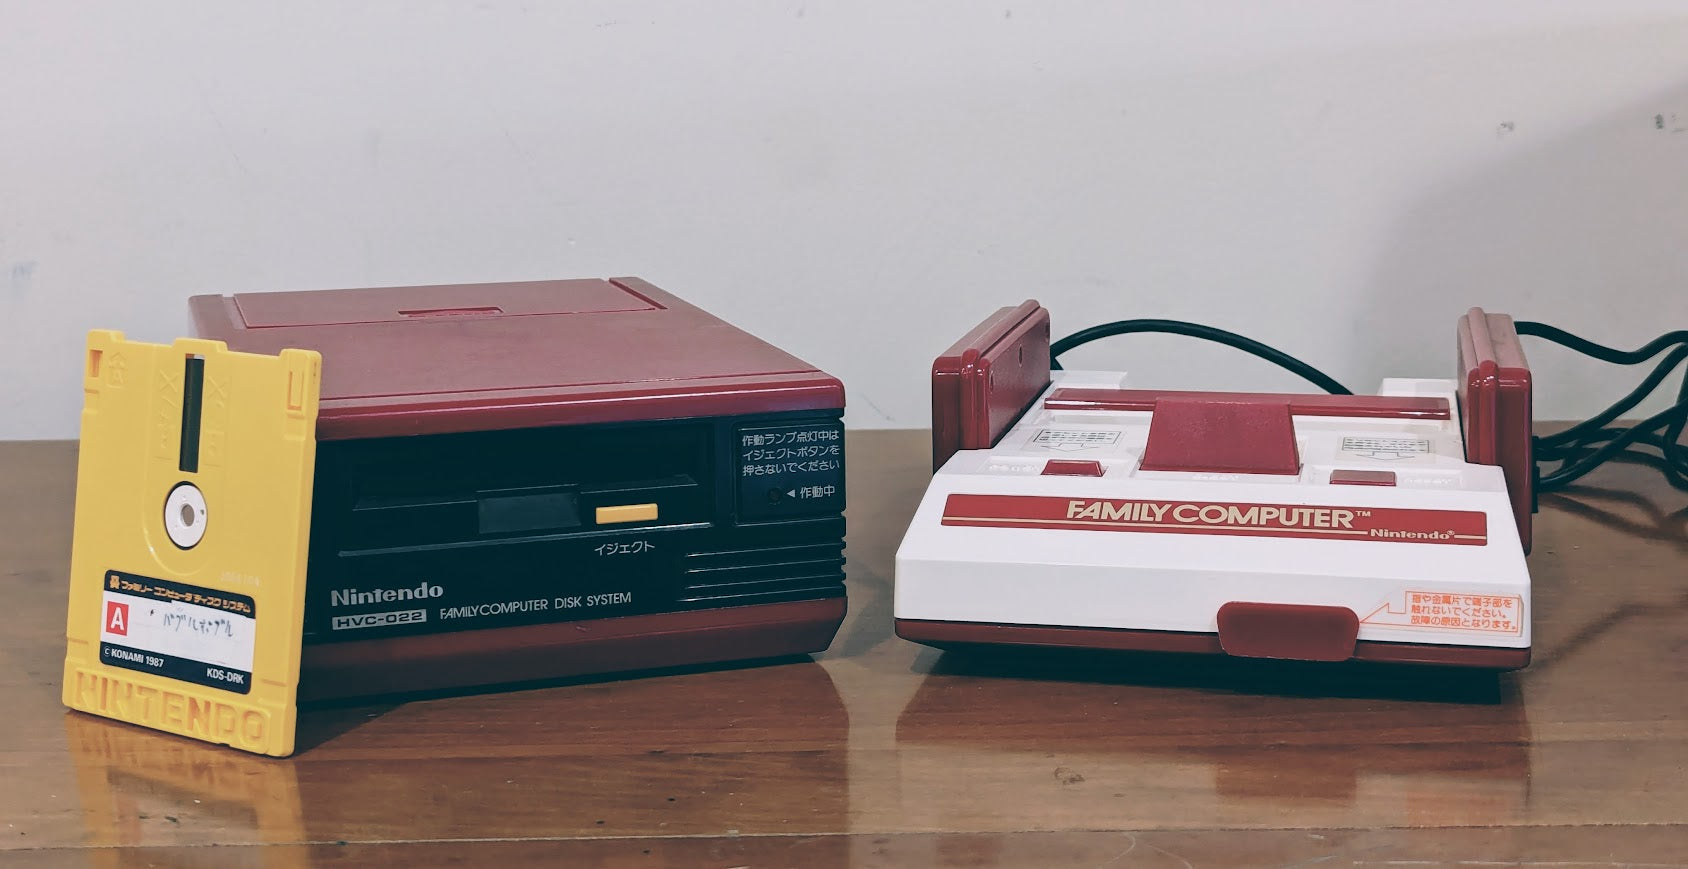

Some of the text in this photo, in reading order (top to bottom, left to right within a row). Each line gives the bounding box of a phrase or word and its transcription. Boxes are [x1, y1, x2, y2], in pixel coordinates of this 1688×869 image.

[742, 430, 839, 446] 作動ランプ点灯中は
[743, 445, 840, 461] イジェクトボタンを
[743, 460, 839, 476] 押さないでください
[800, 485, 835, 499] 作動中
[594, 541, 655, 556] イジェクト
[331, 582, 443, 606] Nintendo
[555, 596, 582, 609] DISK
[587, 592, 632, 607] SYSTEM
[110, 606, 125, 631] A
[337, 611, 423, 628] HVC-022
[146, 656, 164, 668] 1987
[206, 668, 245, 685] KDS-DRK
[74, 669, 271, 747] NINTENDO
